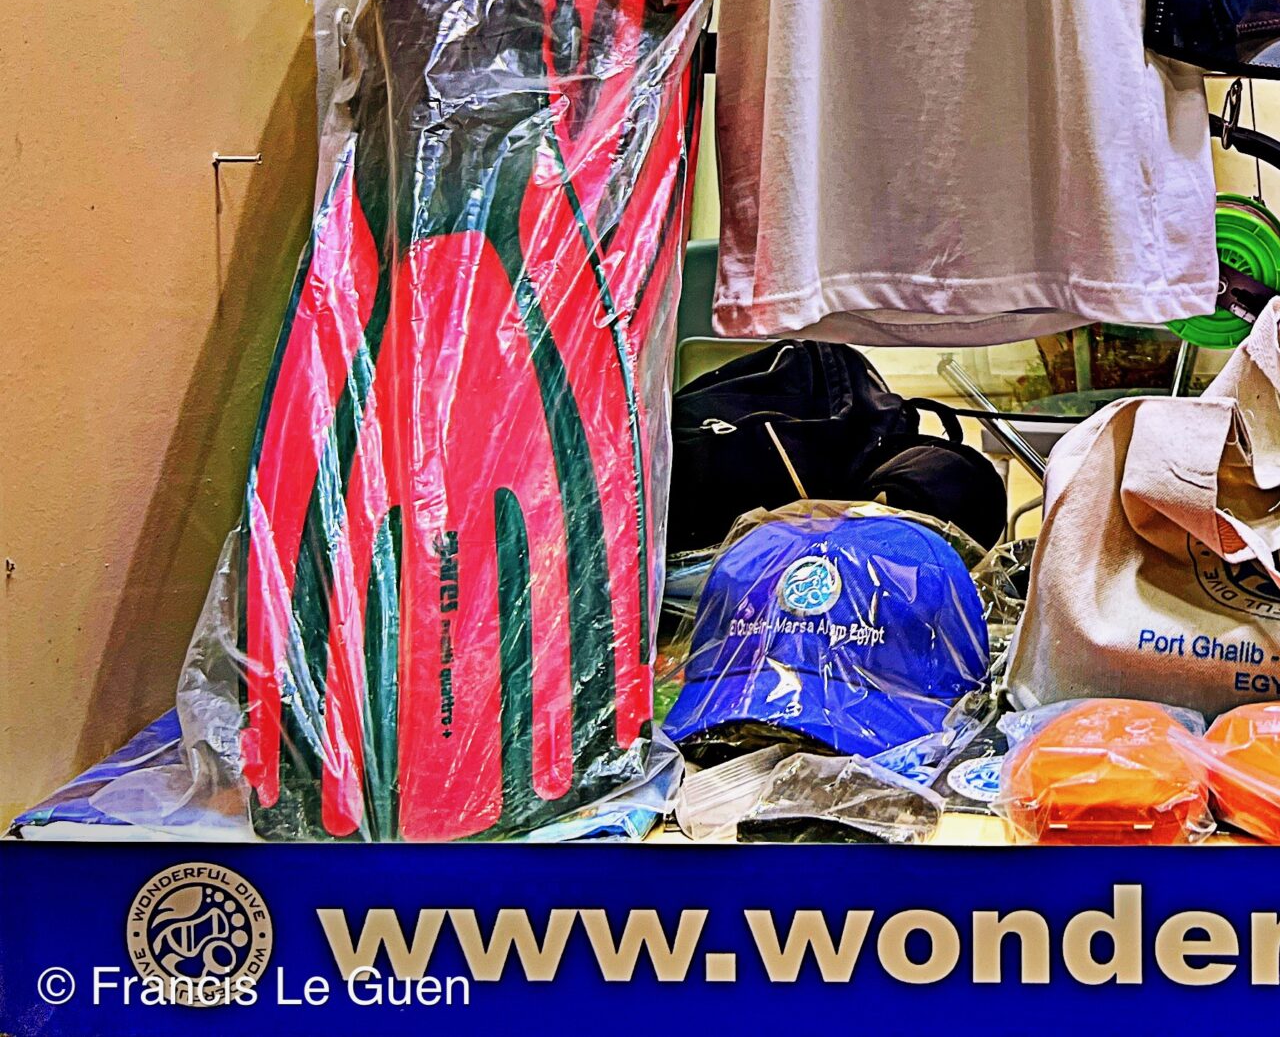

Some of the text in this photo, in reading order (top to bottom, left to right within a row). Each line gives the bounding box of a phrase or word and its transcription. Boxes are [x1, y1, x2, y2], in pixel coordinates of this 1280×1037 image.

[1204, 568, 1238, 600] DIVE
[774, 617, 814, 634] Marsa
[1138, 629, 1184, 656] Port
[1192, 635, 1264, 665] Ghalib
[132, 867, 266, 922] WONDERFUL DIVE
